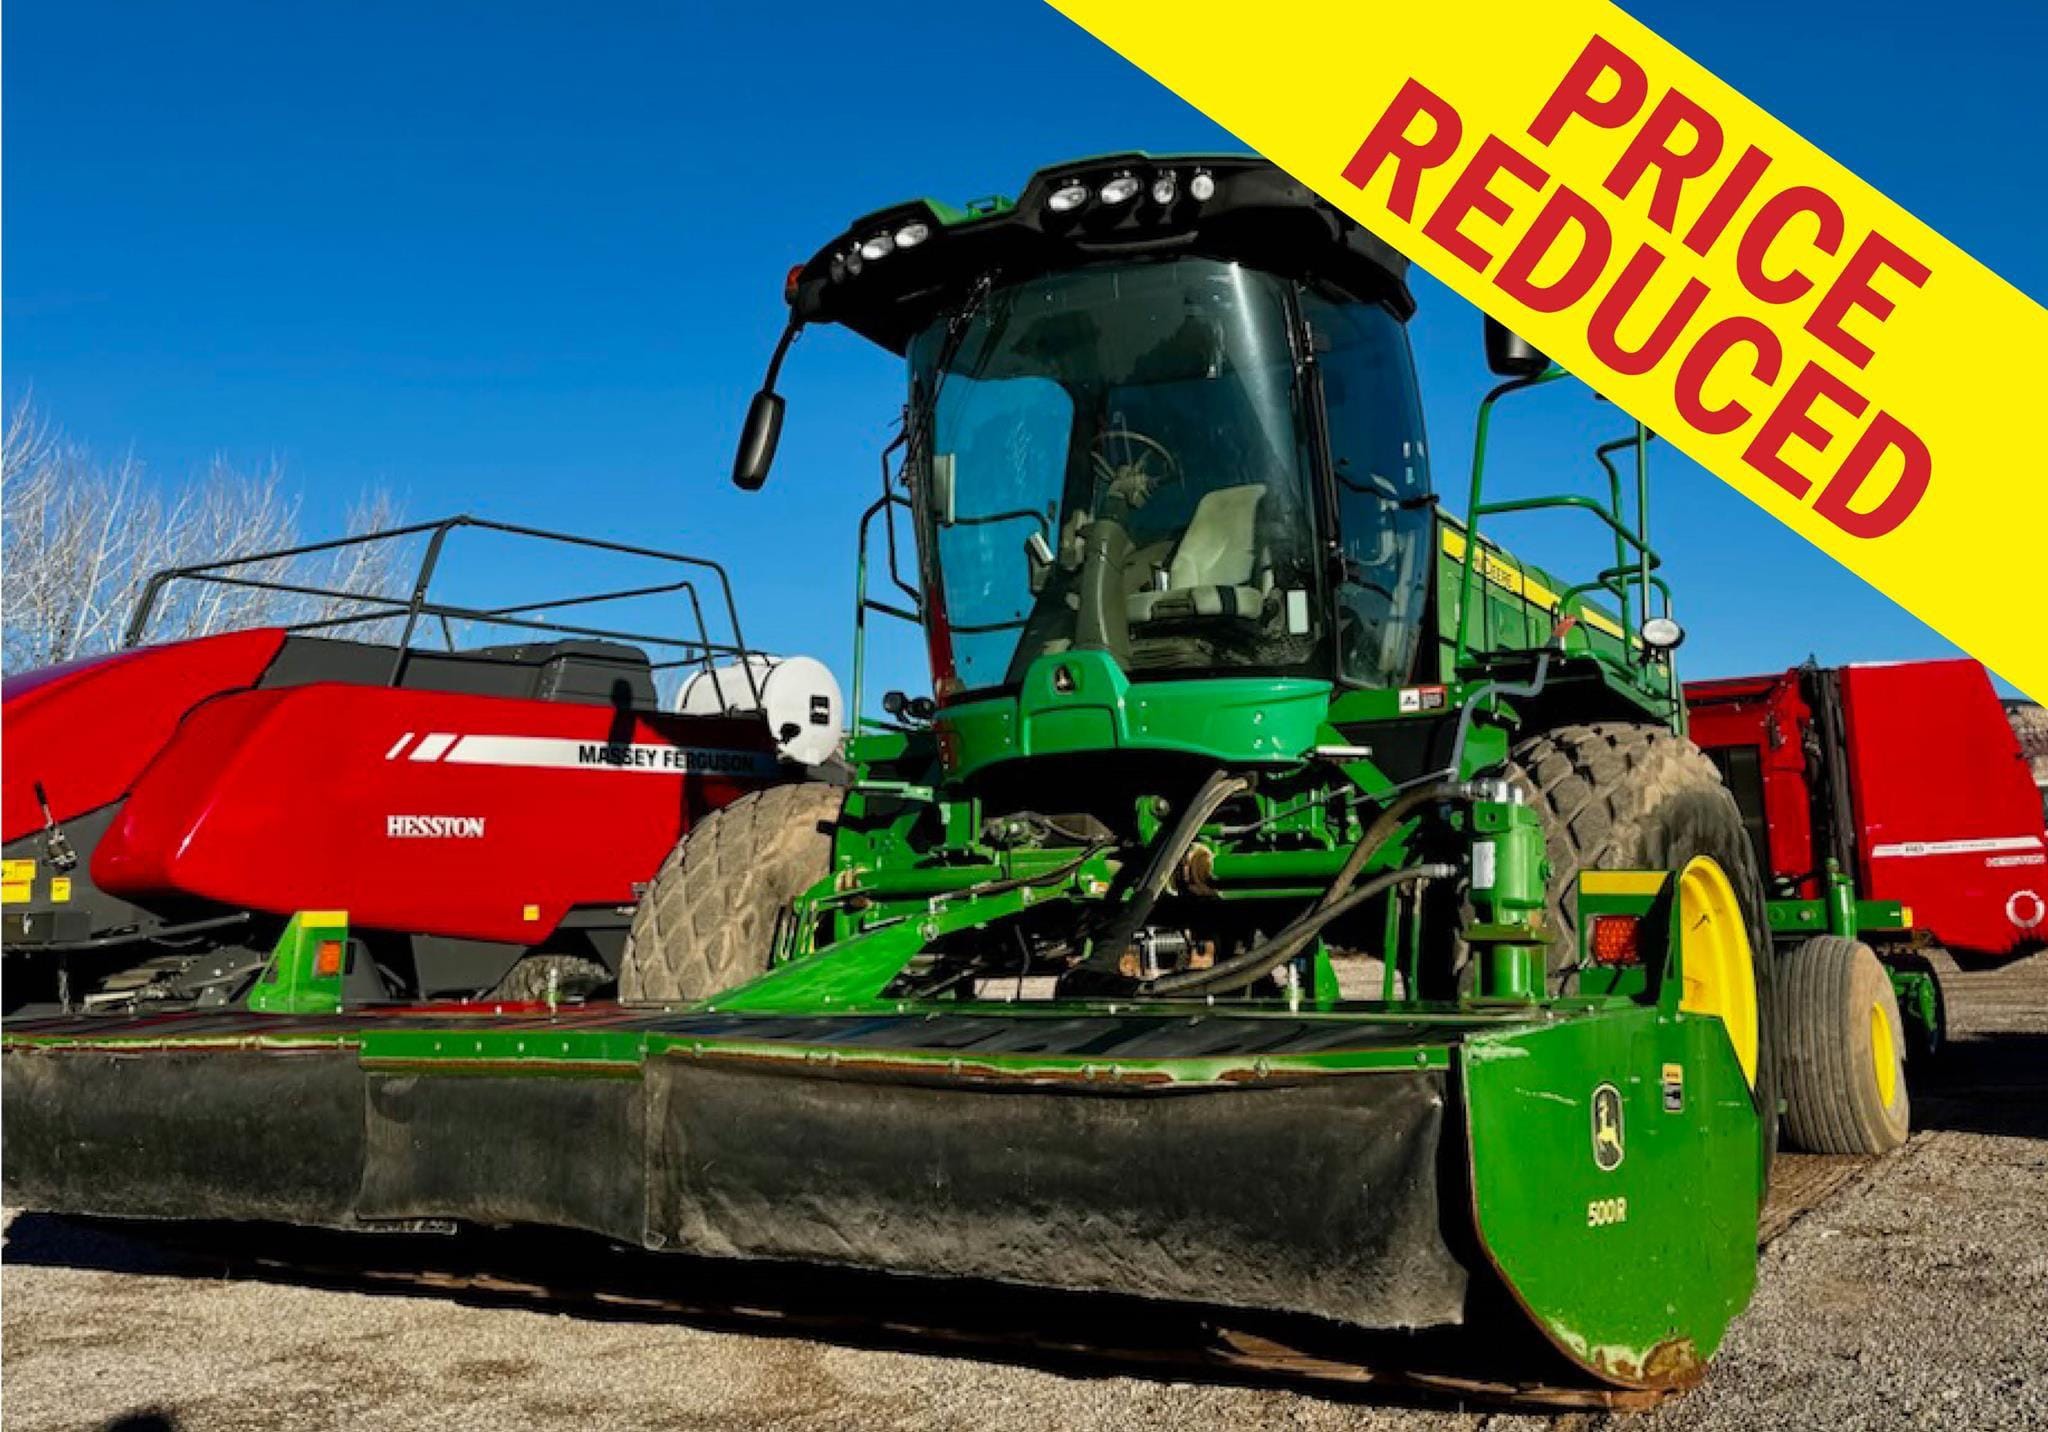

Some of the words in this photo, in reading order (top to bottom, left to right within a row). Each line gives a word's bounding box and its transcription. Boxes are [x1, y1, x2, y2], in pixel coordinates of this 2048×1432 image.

[579, 745, 657, 766] MASSEY
[663, 749, 753, 771] FERGUSON
[386, 814, 486, 838] HESSTON
[1588, 1197, 1627, 1227] 500R
